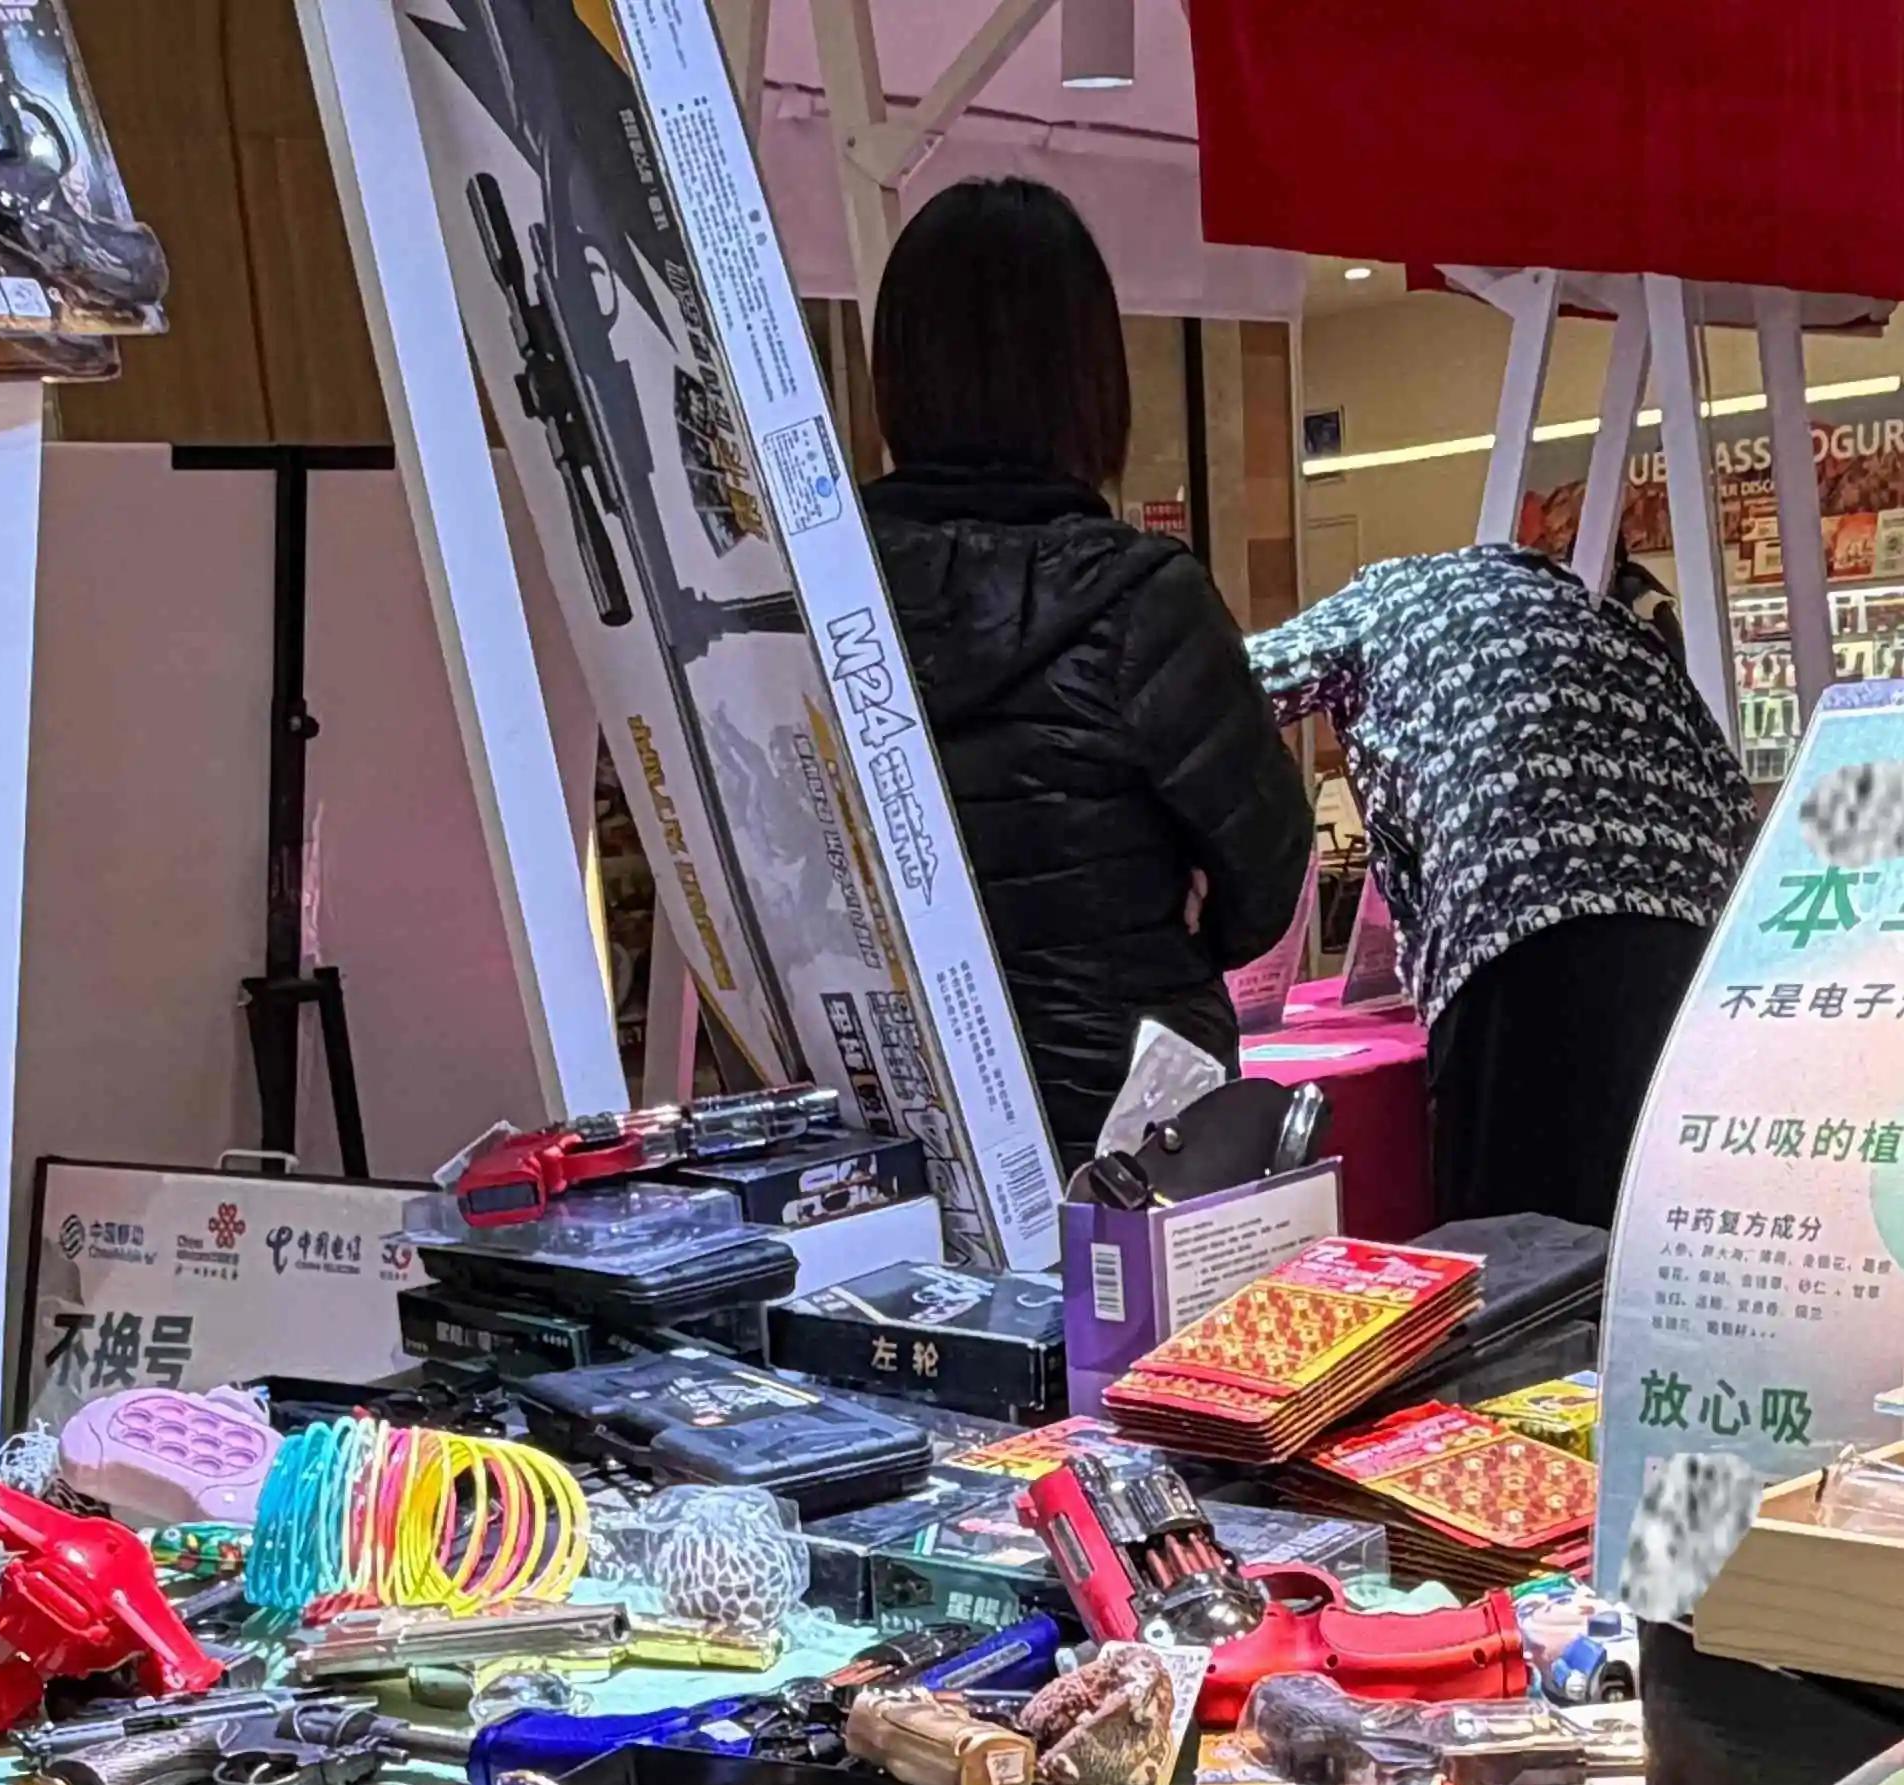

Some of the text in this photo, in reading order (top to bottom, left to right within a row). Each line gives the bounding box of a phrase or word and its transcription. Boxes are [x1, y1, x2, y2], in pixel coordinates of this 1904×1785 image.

[827, 607, 917, 748] M24
[1666, 1206, 1823, 1243] 中药复方成分
[45, 1311, 194, 1395] 不换号
[872, 1335, 939, 1377] 左轮
[1639, 1368, 1814, 1446] 放心吸
